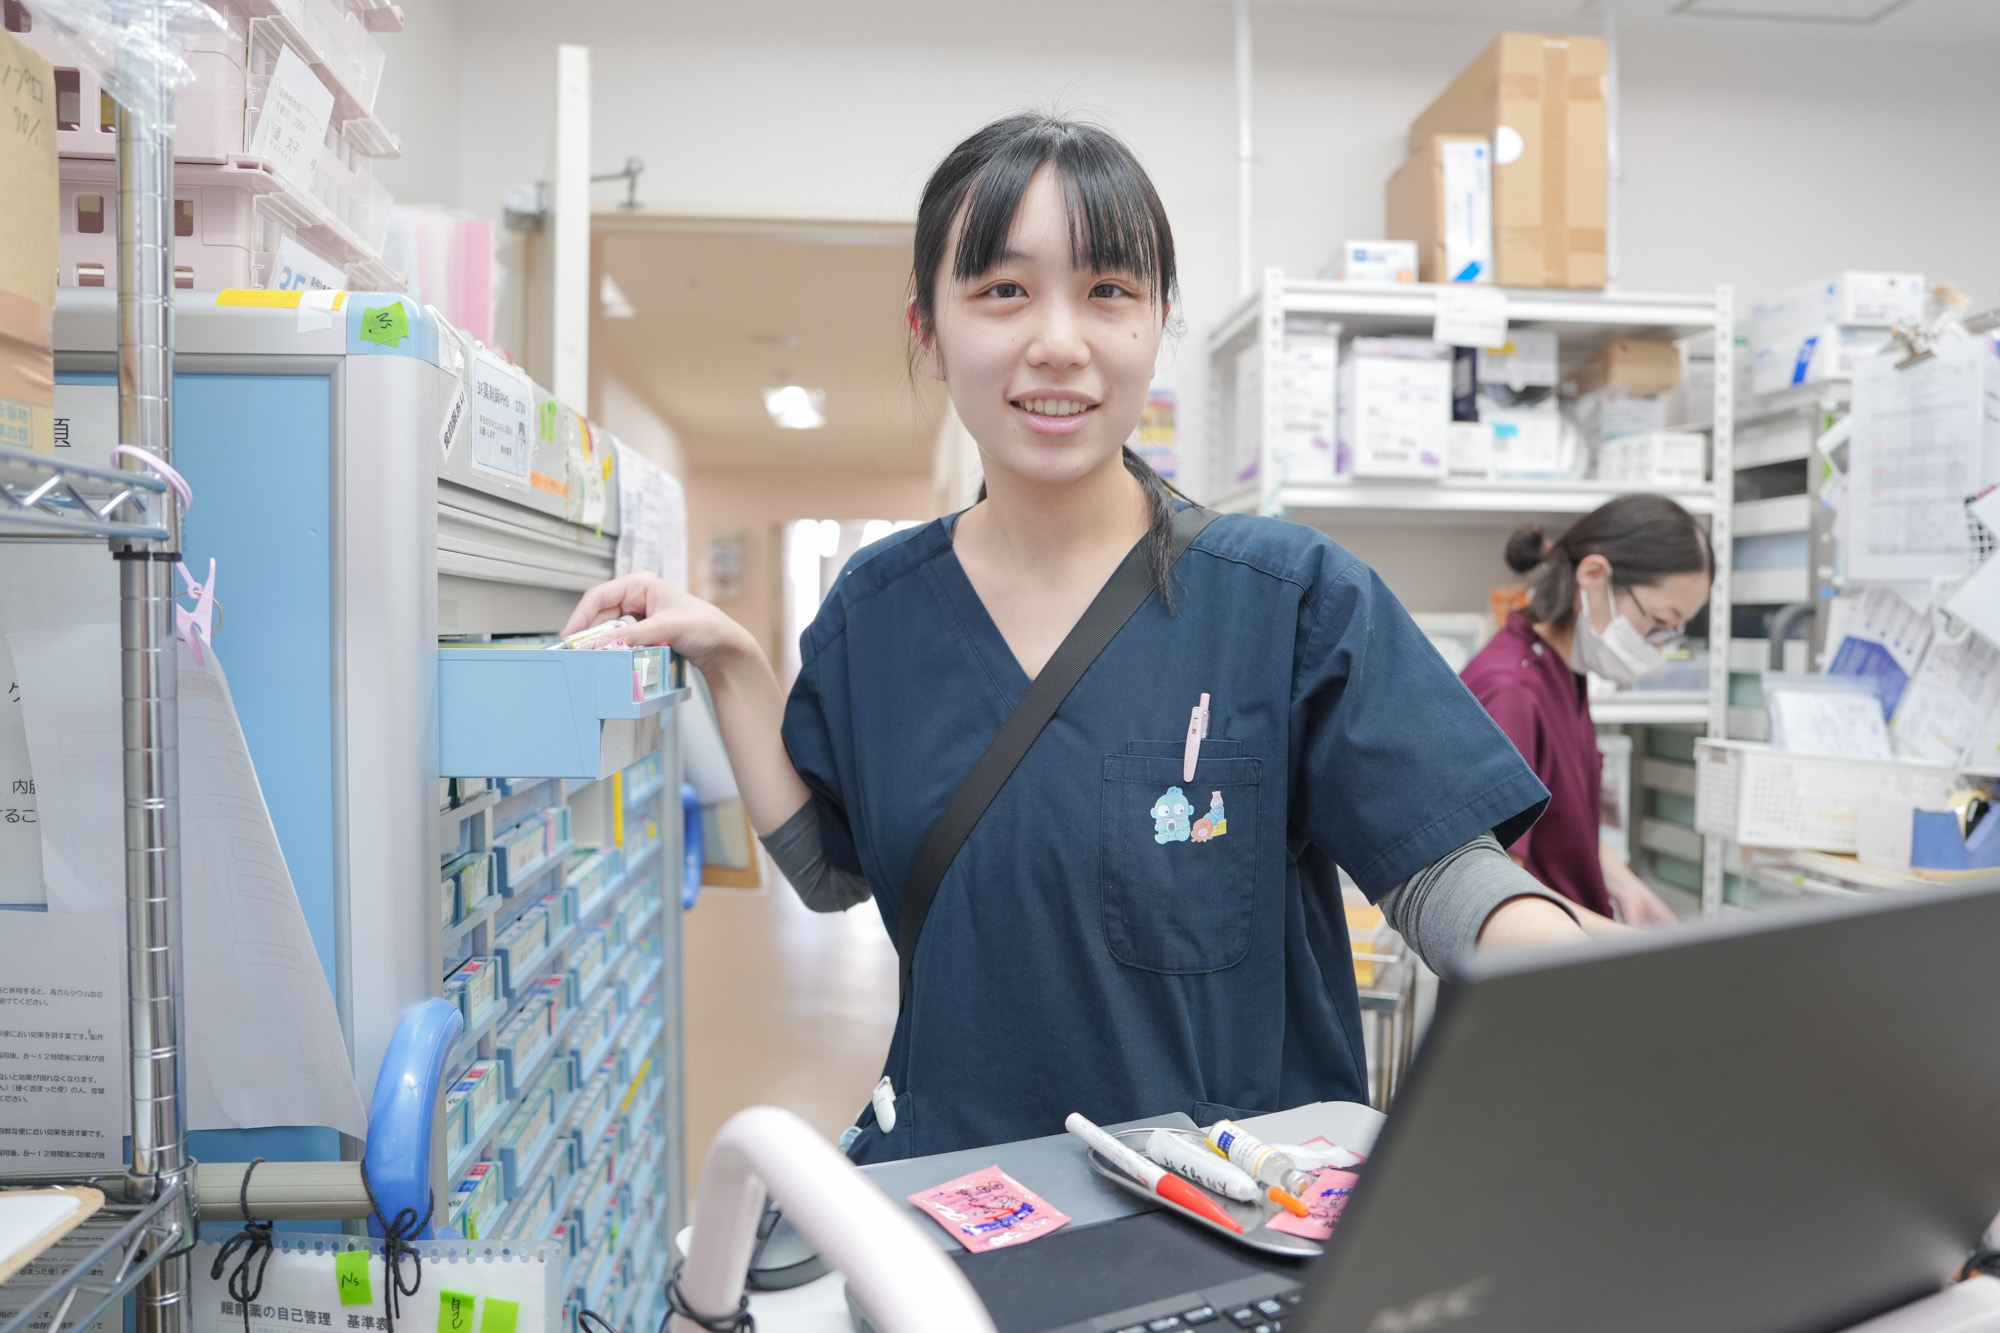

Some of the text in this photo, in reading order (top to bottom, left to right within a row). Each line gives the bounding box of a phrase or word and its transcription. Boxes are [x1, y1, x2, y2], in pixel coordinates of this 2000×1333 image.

[0, 808, 37, 824] るこ
[0, 986, 104, 999] と併用すると、高カルシウム血症
[341, 1272, 360, 1288] Ns
[220, 1300, 390, 1332] 眠前薬の自己管理 基準表
